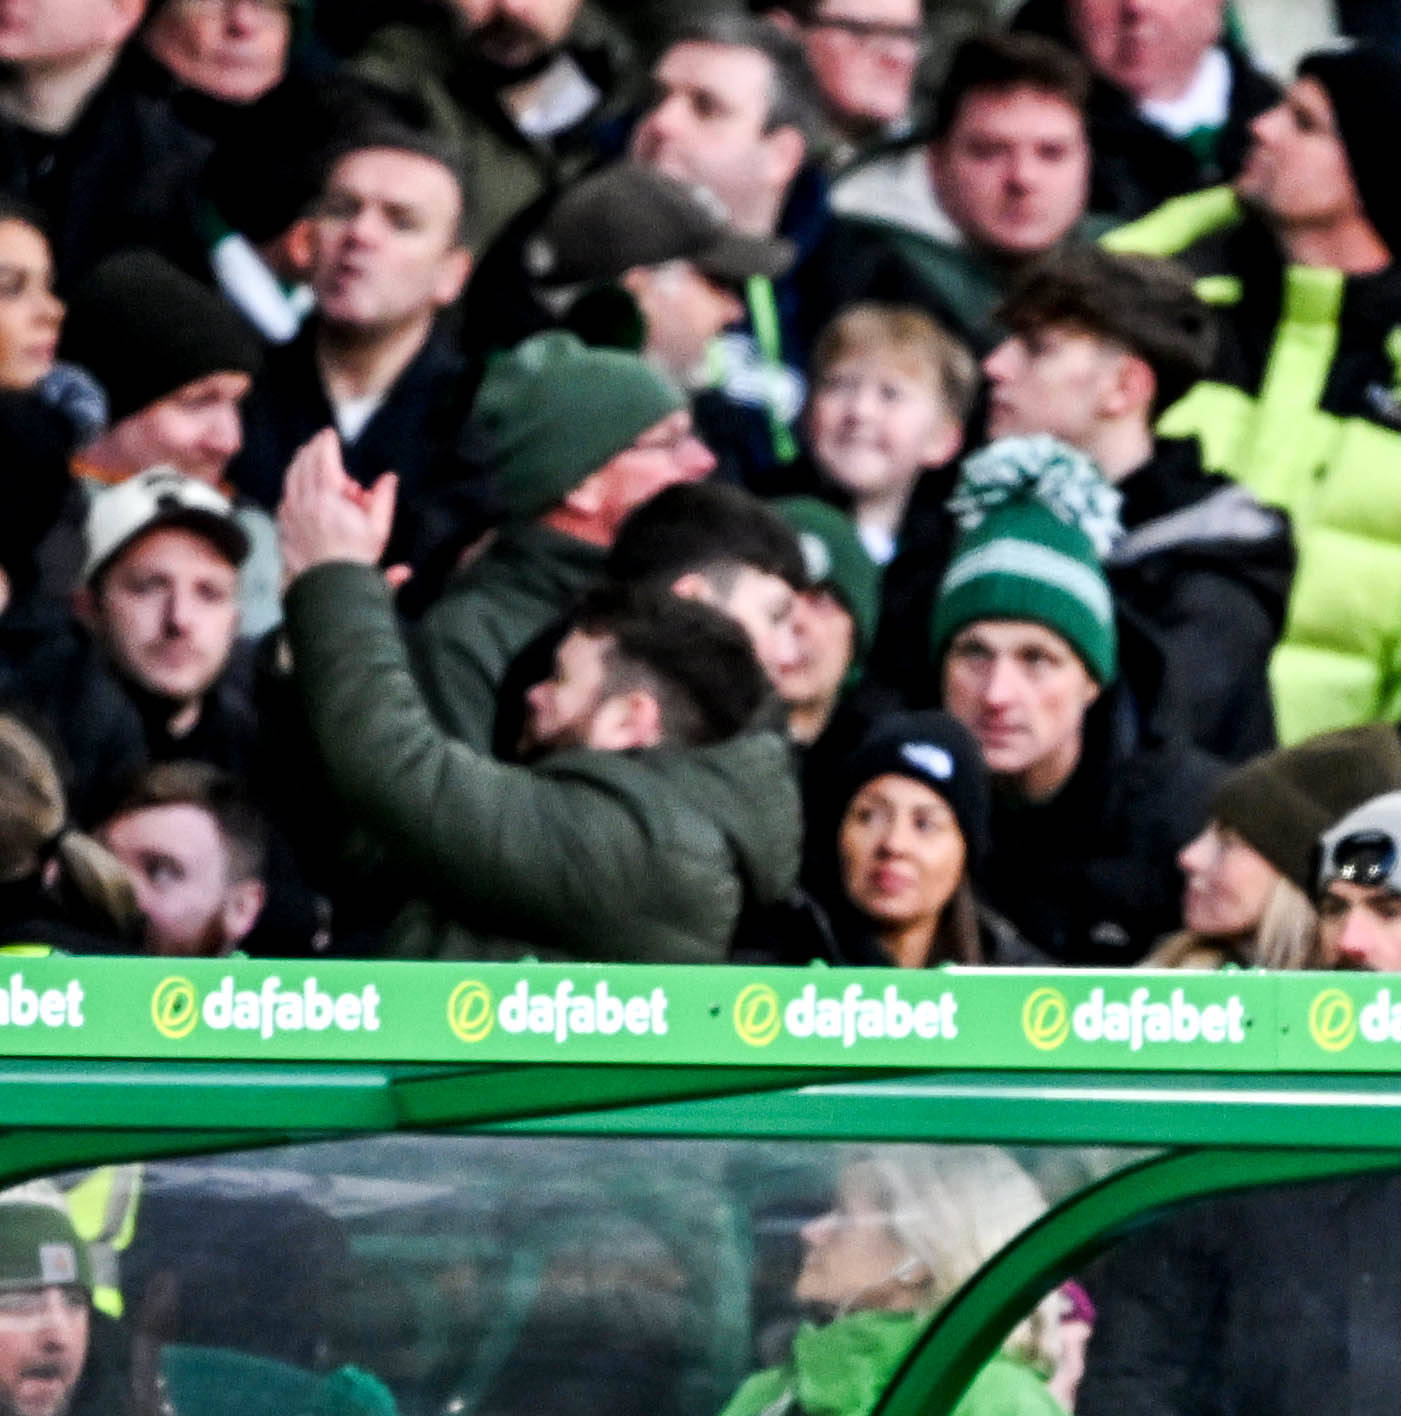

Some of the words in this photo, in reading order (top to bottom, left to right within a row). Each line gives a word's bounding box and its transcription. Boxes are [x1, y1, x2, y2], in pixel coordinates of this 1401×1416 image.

[203, 976, 381, 1039] dafabet
[499, 980, 668, 1043] dafabet
[784, 983, 957, 1048] dafabet
[1073, 987, 1246, 1052] dafabet
